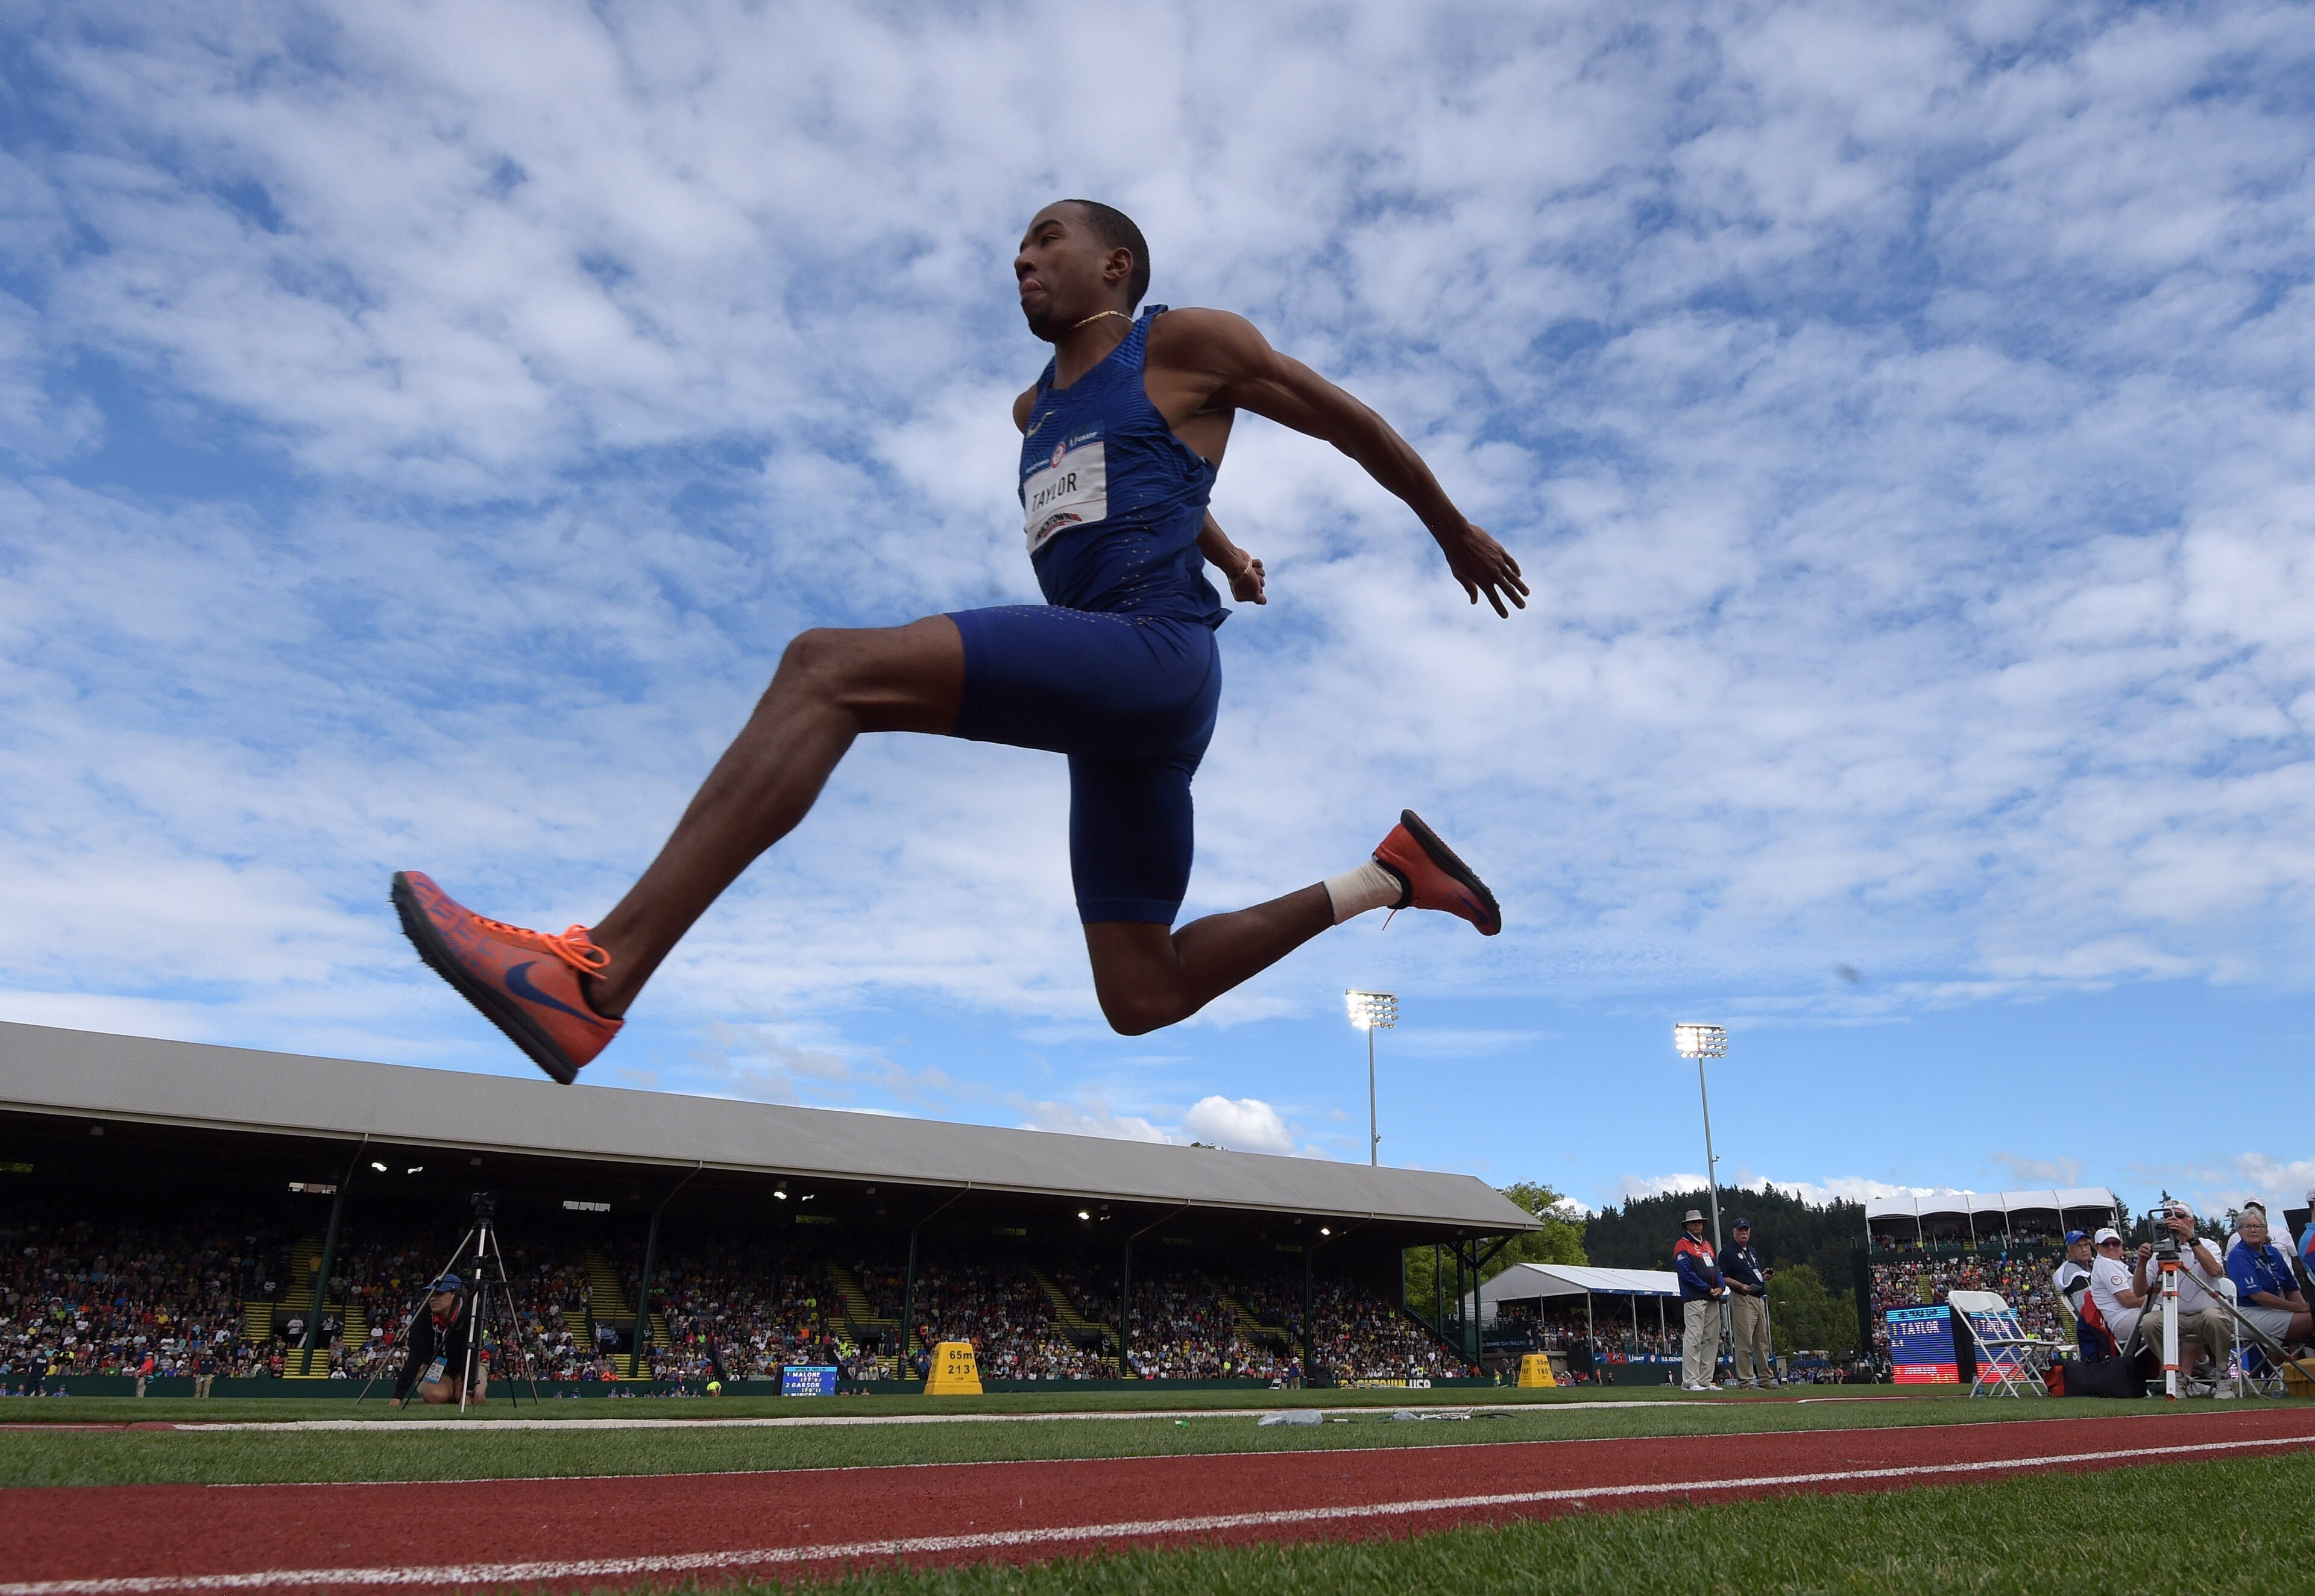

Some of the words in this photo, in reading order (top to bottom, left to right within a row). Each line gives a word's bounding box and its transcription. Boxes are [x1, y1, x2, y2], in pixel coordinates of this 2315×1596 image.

[1032, 472, 1077, 512] TAYLOR
[1900, 1321, 1940, 1334] TAYLOR
[950, 1351, 972, 1360] 65m
[948, 1364, 975, 1374] 213'
[1409, 1379, 1431, 1389] USA
